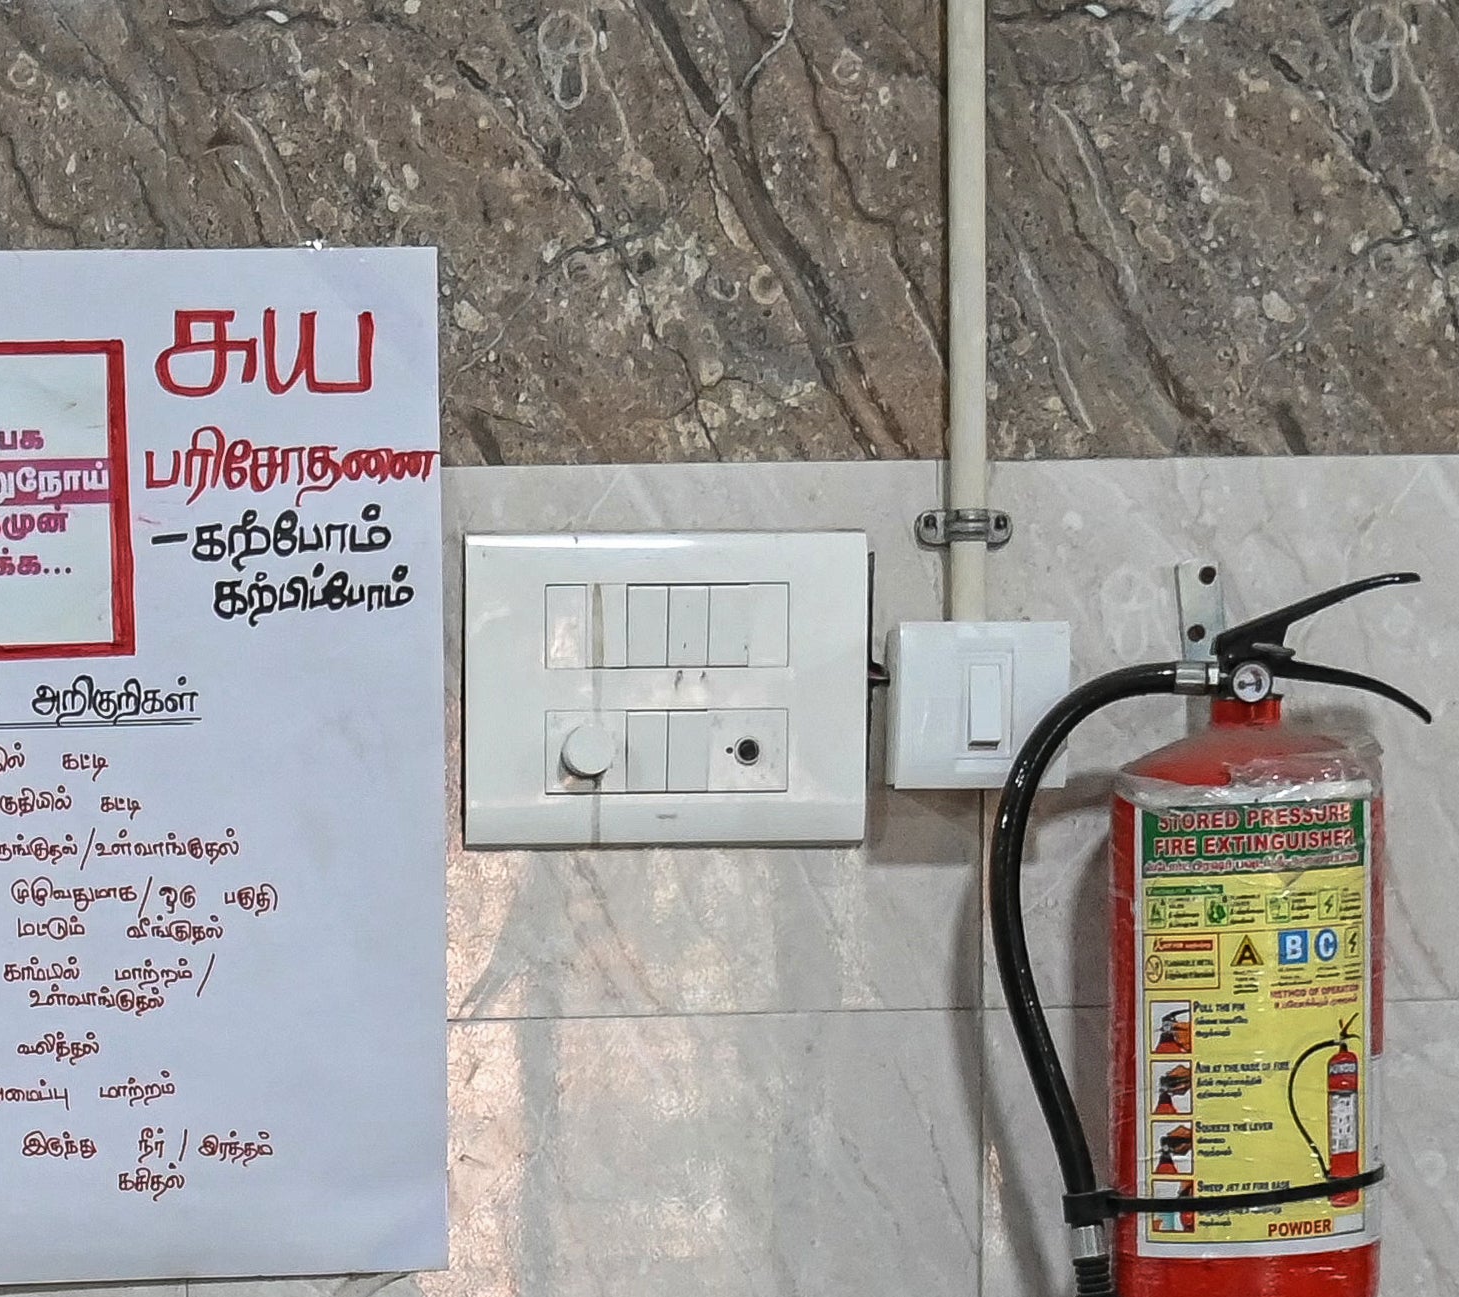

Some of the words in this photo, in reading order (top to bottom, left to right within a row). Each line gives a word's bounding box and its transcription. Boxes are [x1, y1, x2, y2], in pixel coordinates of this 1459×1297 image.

[154, 306, 375, 396] சுய
[214, 563, 414, 627] கற்பிப்போம்
[31, 675, 199, 727] அறிகுறிகள்
[62, 752, 109, 781] கட்டி
[100, 794, 142, 820] கட்டி
[1158, 810, 1240, 832] STORED
[1245, 802, 1351, 828] PRESSURE
[1154, 837, 1196, 857] FIRE
[1204, 828, 1355, 855] EXTINGUISHER
[224, 883, 279, 916] பகுதி
[17, 915, 88, 940] மட்டும்
[126, 914, 224, 945] வீங்குதல்
[1237, 944, 1257, 965] A
[1286, 935, 1302, 959] B
[1319, 933, 1333, 958] C
[3, 956, 81, 982] காம்பில்
[29, 983, 166, 1015] உள்வாங்குதல்
[1194, 1002, 1213, 1012] PULL
[17, 1031, 101, 1065] வலித்தல்
[100, 1070, 176, 1106] மாற்றம்
[1249, 1122, 1273, 1131] LEVER
[22, 1129, 98, 1160] இருந்து
[138, 1127, 165, 1164] நீர்
[198, 1130, 274, 1167] இரத்தம்
[118, 1162, 186, 1202] கசிதல்
[1268, 1219, 1332, 1237] POWDER
